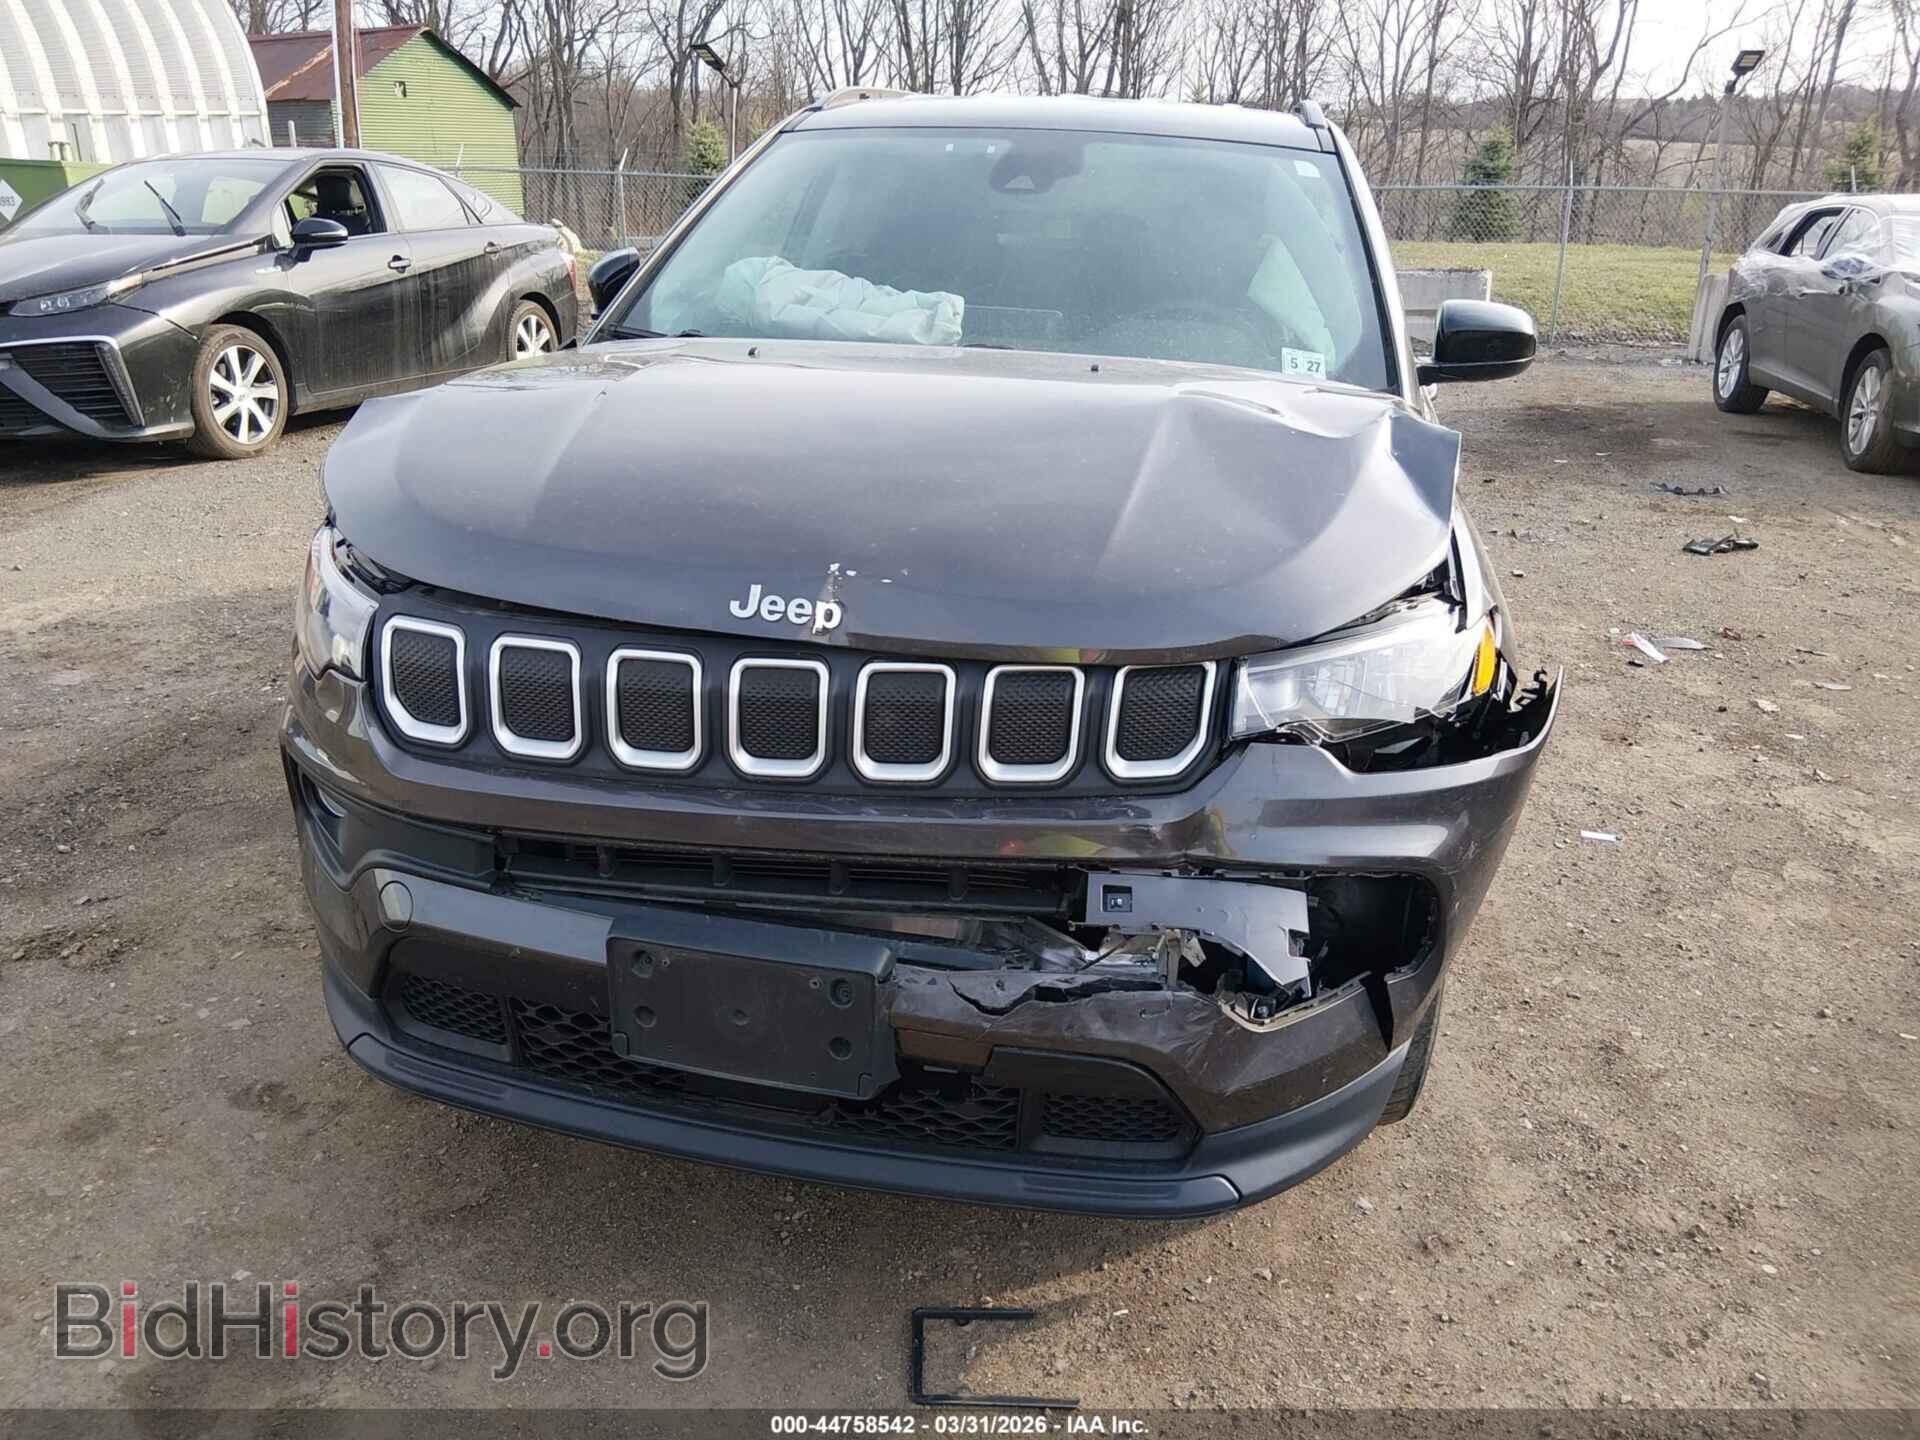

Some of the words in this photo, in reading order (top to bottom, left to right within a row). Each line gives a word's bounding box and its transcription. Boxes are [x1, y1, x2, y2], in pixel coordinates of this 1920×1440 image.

[1290, 356, 1298, 369] 5
[1306, 360, 1321, 373] 27
[729, 584, 842, 634] Jeep
